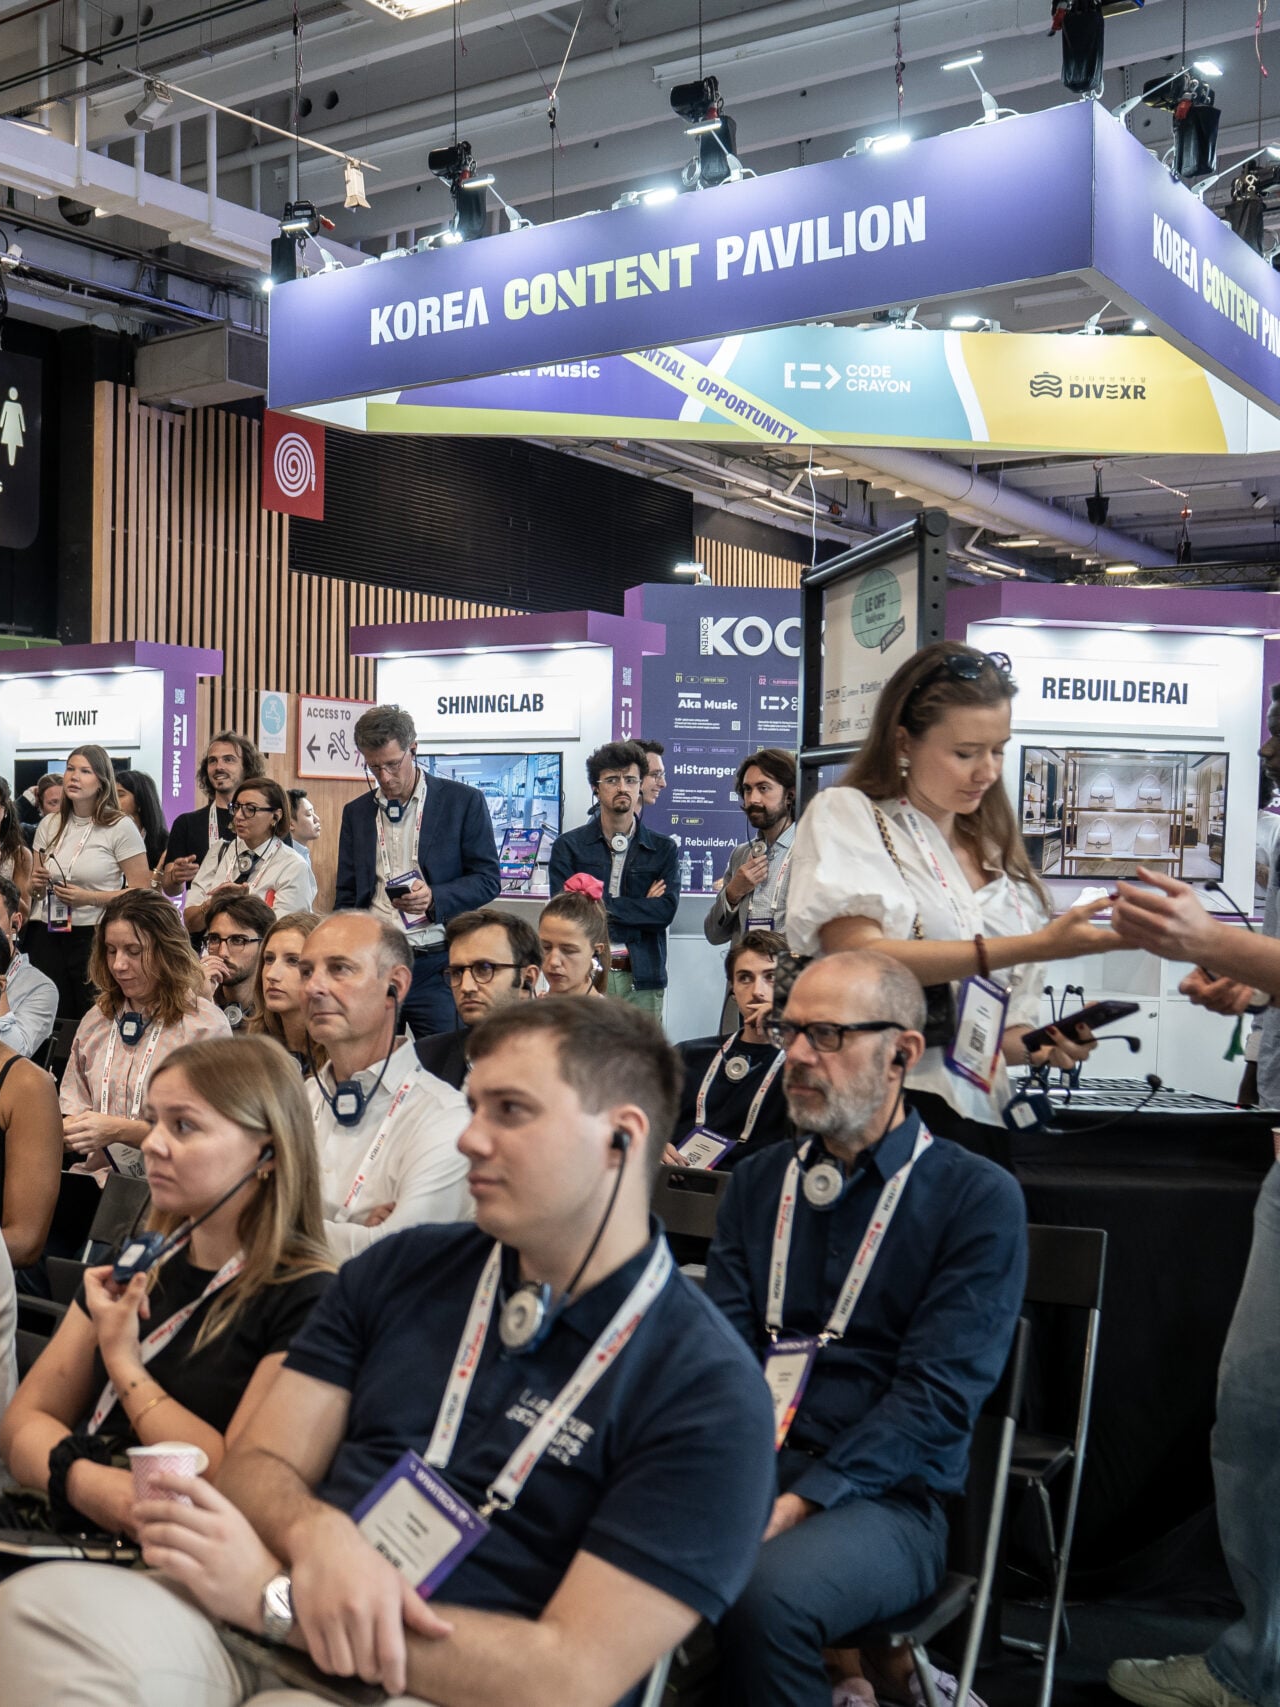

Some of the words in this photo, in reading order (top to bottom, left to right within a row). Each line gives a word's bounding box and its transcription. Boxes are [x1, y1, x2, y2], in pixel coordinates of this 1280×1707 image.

[370, 286, 489, 346] KOREA
[503, 243, 700, 321] CONTENT
[716, 195, 926, 282] PAVILION
[1153, 212, 1198, 293] KOREA
[1202, 257, 1259, 340] CONTENT
[846, 364, 892, 378] CODE
[636, 349, 686, 381] NTIAL
[696, 377, 798, 443] OPPORTUNITY
[846, 378, 911, 393] CRAYON
[700, 616, 801, 657] KOC
[1042, 677, 1189, 704] REBUILDERAI
[306, 707, 339, 720] ACCESS
[340, 709, 351, 720] TO
[437, 693, 545, 715] SHININGLAB
[678, 699, 701, 709] Aka
[704, 699, 738, 710] Music
[55, 710, 99, 726] TWINIT
[173, 713, 182, 746] Aka
[172, 750, 182, 797] Music
[674, 763, 737, 778] HiStranger
[685, 836, 738, 847] RebuilderAI
